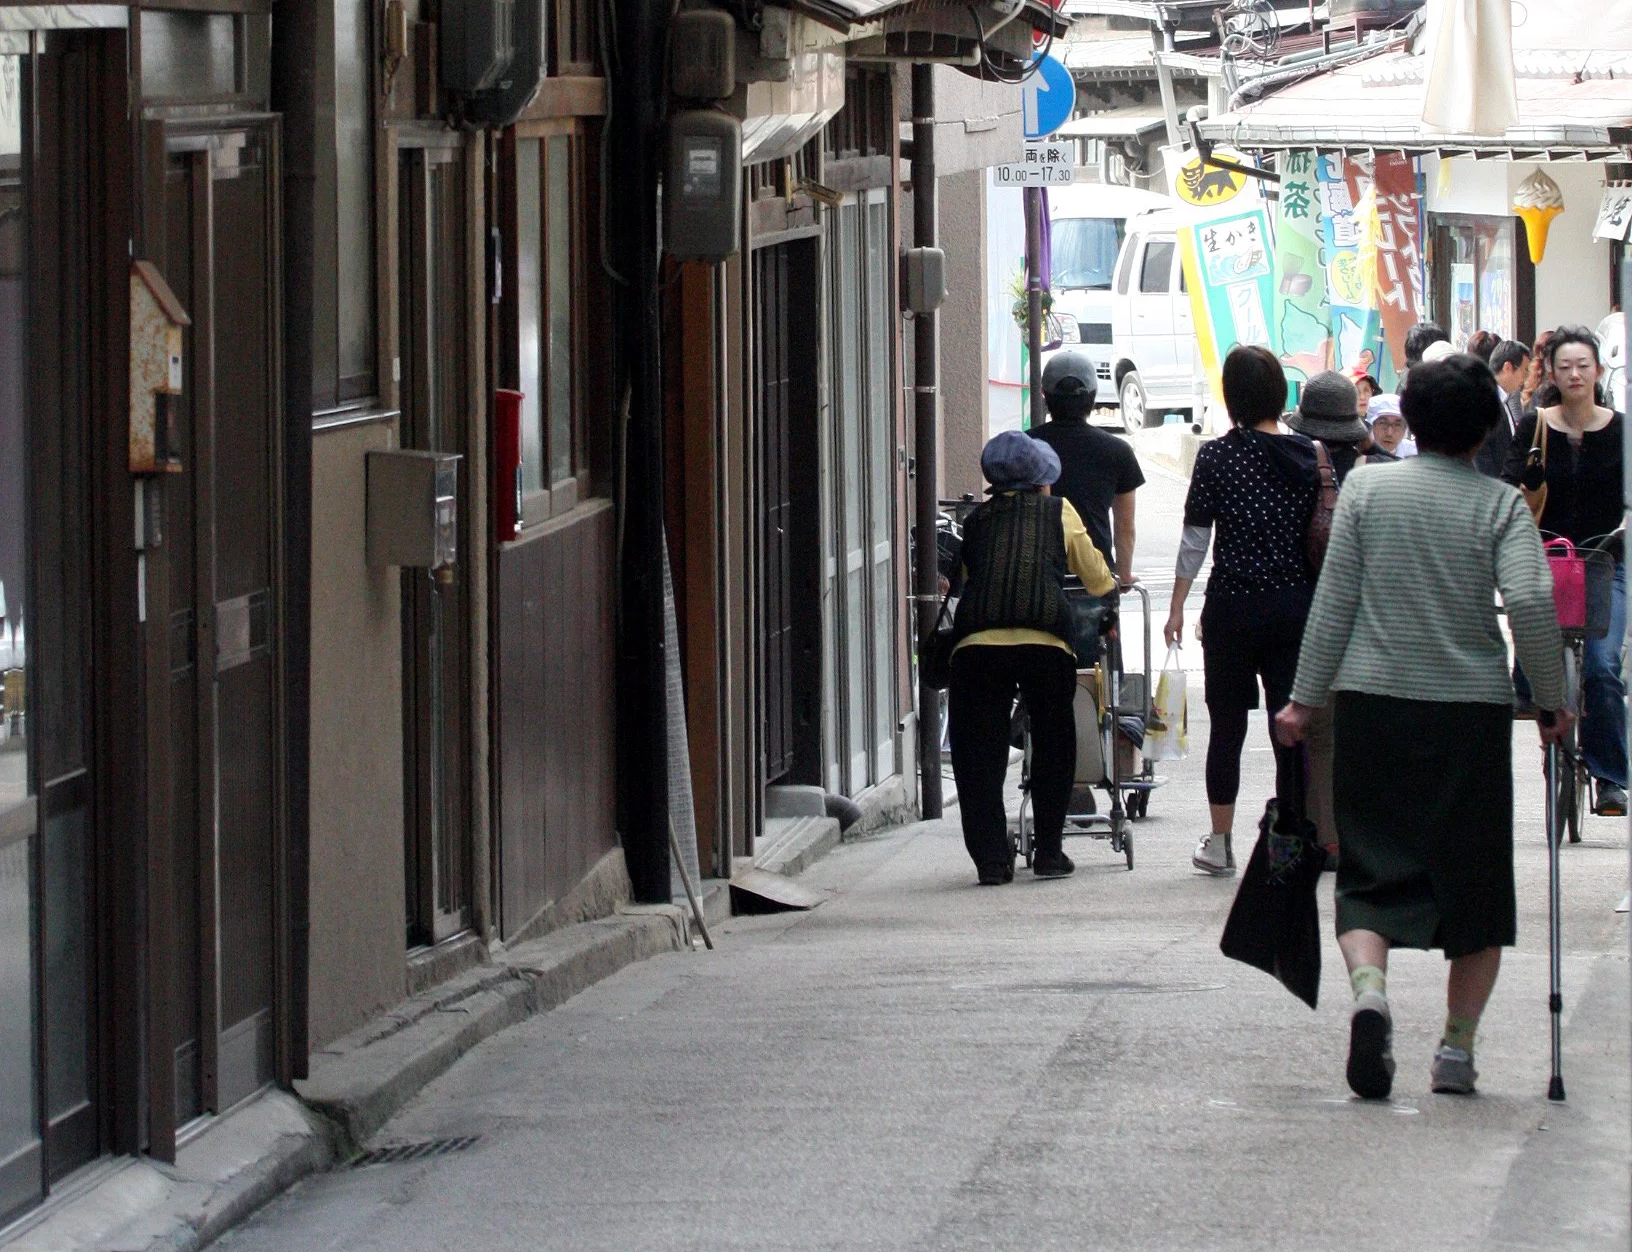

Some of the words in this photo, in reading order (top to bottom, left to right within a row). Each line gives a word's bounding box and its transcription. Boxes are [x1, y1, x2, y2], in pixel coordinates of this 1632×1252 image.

[1022, 148, 1067, 163] 両を除く
[1203, 220, 1257, 253] 生かき
